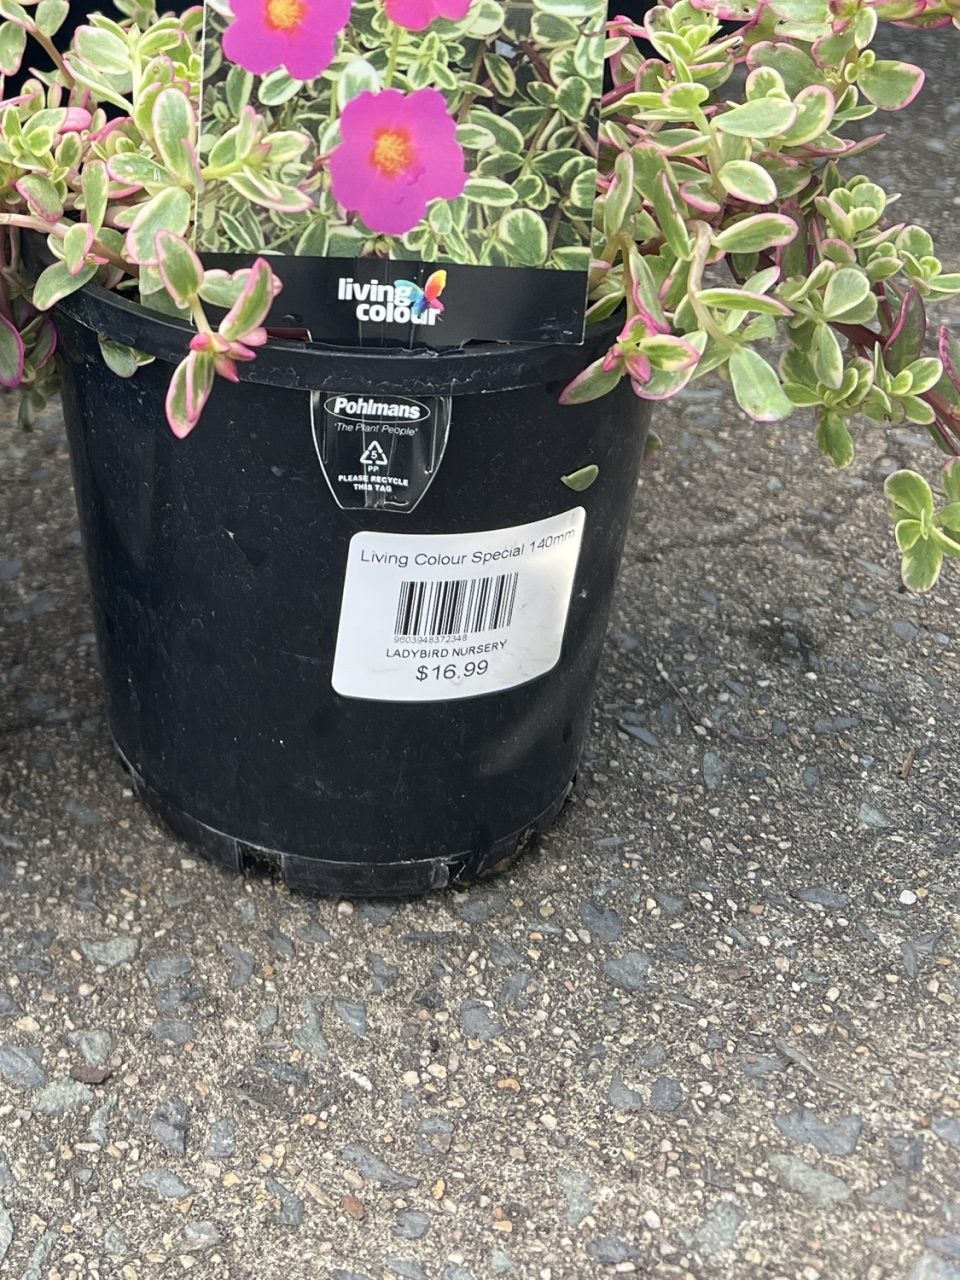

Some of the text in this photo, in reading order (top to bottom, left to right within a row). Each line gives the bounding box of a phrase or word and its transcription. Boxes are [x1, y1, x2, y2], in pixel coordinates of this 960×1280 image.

[337, 278, 412, 307] living
[356, 302, 440, 326] colour
[334, 397, 421, 420] Pohlmans
[355, 422, 380, 434] Plant
[371, 450, 378, 460] 5
[368, 465, 379, 473] PP
[338, 475, 409, 487] PLEASE RECYCLE
[353, 483, 392, 493] THIS TAG
[360, 528, 576, 568] Living Colour Special 140mm
[393, 634, 468, 644] 9603948372348
[386, 639, 509, 659] LADYBIRD NURSERY
[416, 659, 489, 683] $16.99
